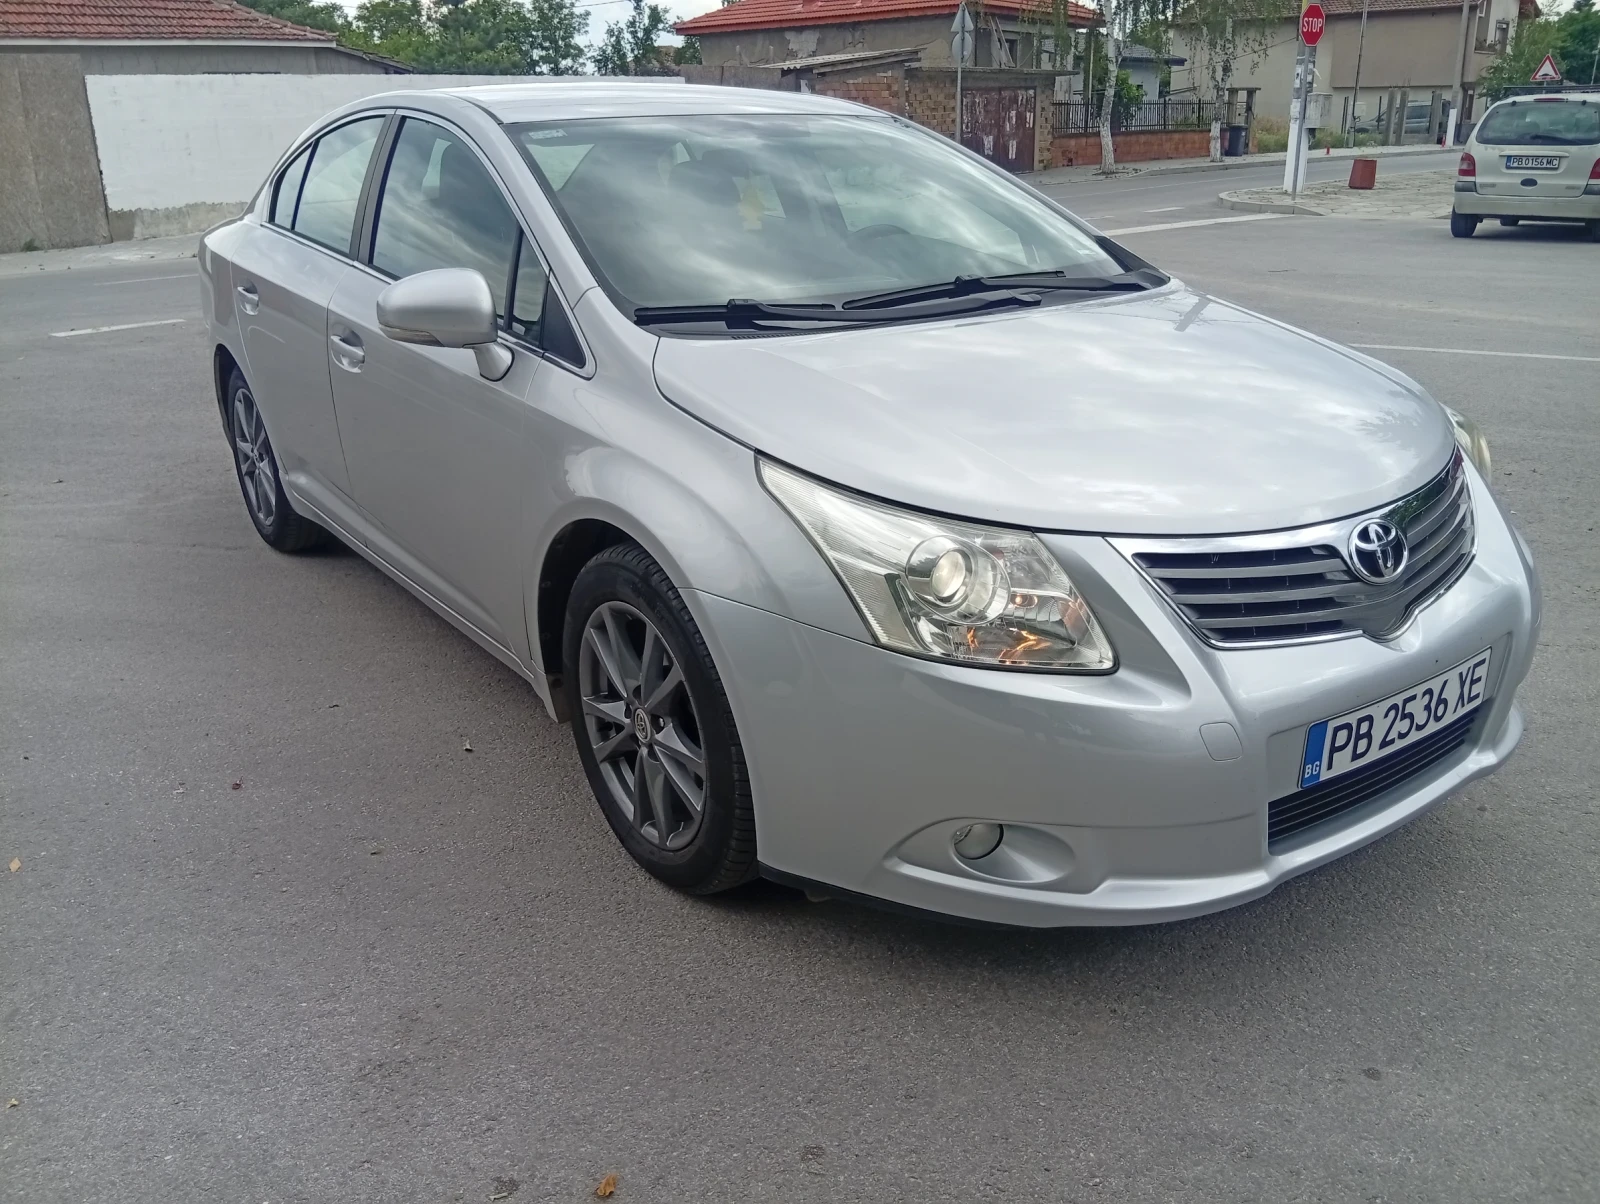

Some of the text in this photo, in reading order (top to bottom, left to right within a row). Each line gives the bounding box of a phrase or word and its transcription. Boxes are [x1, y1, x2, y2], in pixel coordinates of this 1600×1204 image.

[1303, 18, 1322, 32] STOP
[1511, 157, 1523, 166] PB
[1524, 157, 1545, 166] 0156
[1546, 158, 1558, 167] MC
[1326, 657, 1487, 771] PB 2536 XE
[1304, 761, 1320, 779] BG
